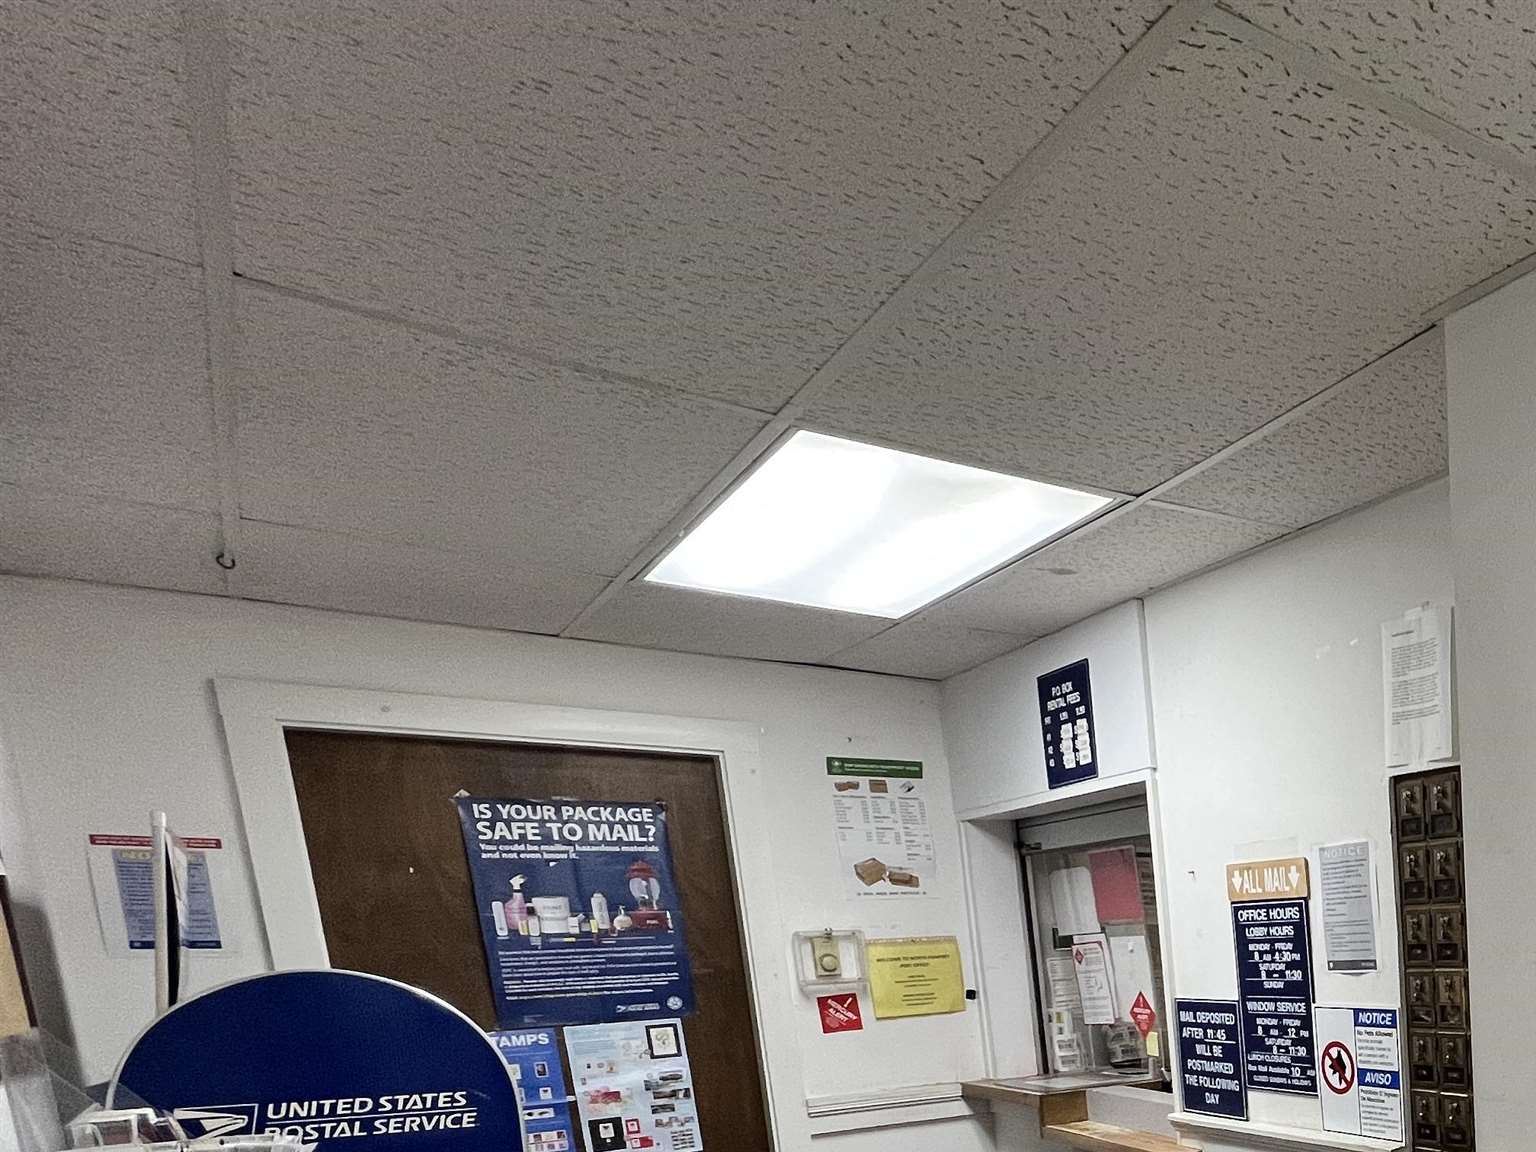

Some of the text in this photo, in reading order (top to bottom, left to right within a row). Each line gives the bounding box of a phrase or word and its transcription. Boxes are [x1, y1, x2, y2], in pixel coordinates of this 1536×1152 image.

[472, 803, 655, 822] IS YOUR PACKAGE
[476, 821, 656, 842] SAFE TO MAIL?
[480, 843, 497, 851] You
[1243, 866, 1289, 894] ALL MAIL
[1238, 907, 1300, 921] OFFICE HOURS
[1245, 925, 1294, 937] LOBBY HOURS
[1246, 1001, 1307, 1013] WINDOW SERVICE
[1180, 1010, 1235, 1025] MAIL DEPOSITED
[1358, 1012, 1392, 1025] NOTICE
[1182, 1027, 1226, 1040] AFTER 11:45
[1288, 1027, 1296, 1037] 12
[490, 1033, 549, 1048] TAMPS
[1195, 1044, 1223, 1057] WILL BE
[1187, 1059, 1234, 1074] POSTMARKED
[1291, 1066, 1301, 1077] 10
[1185, 1074, 1240, 1091] THE FOLLOWING
[1364, 1071, 1392, 1085] AVISO
[1205, 1092, 1219, 1104] DAY
[267, 1091, 467, 1120] UNITED STATES
[372, 1112, 478, 1135] SERVICE
